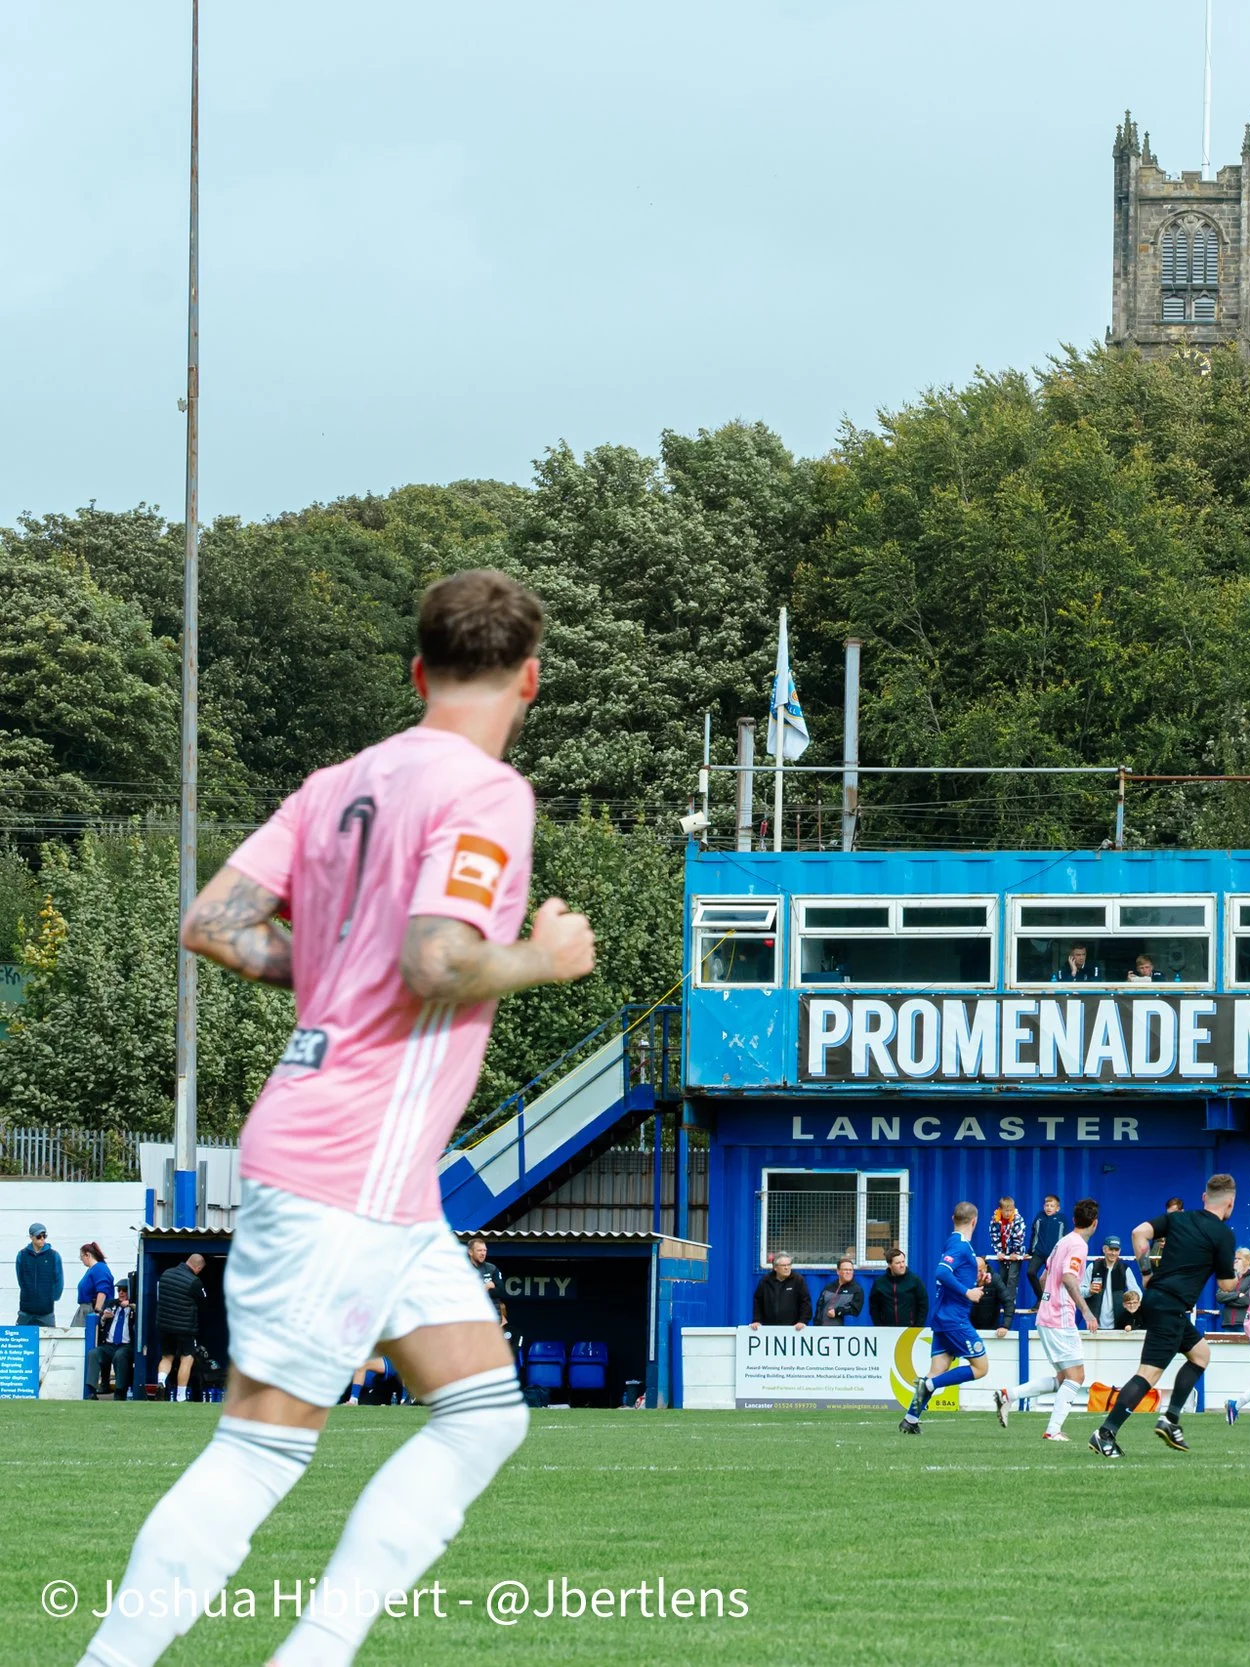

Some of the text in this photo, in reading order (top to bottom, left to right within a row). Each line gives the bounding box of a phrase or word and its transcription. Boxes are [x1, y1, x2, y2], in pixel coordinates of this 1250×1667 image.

[808, 998, 1218, 1079] PROMENADE
[792, 1116, 1140, 1142] LANCASTER
[504, 1276, 572, 1297] CITY
[748, 1335, 878, 1357] PININGTON
[826, 1402, 888, 1410] www.pinington.co.uk
